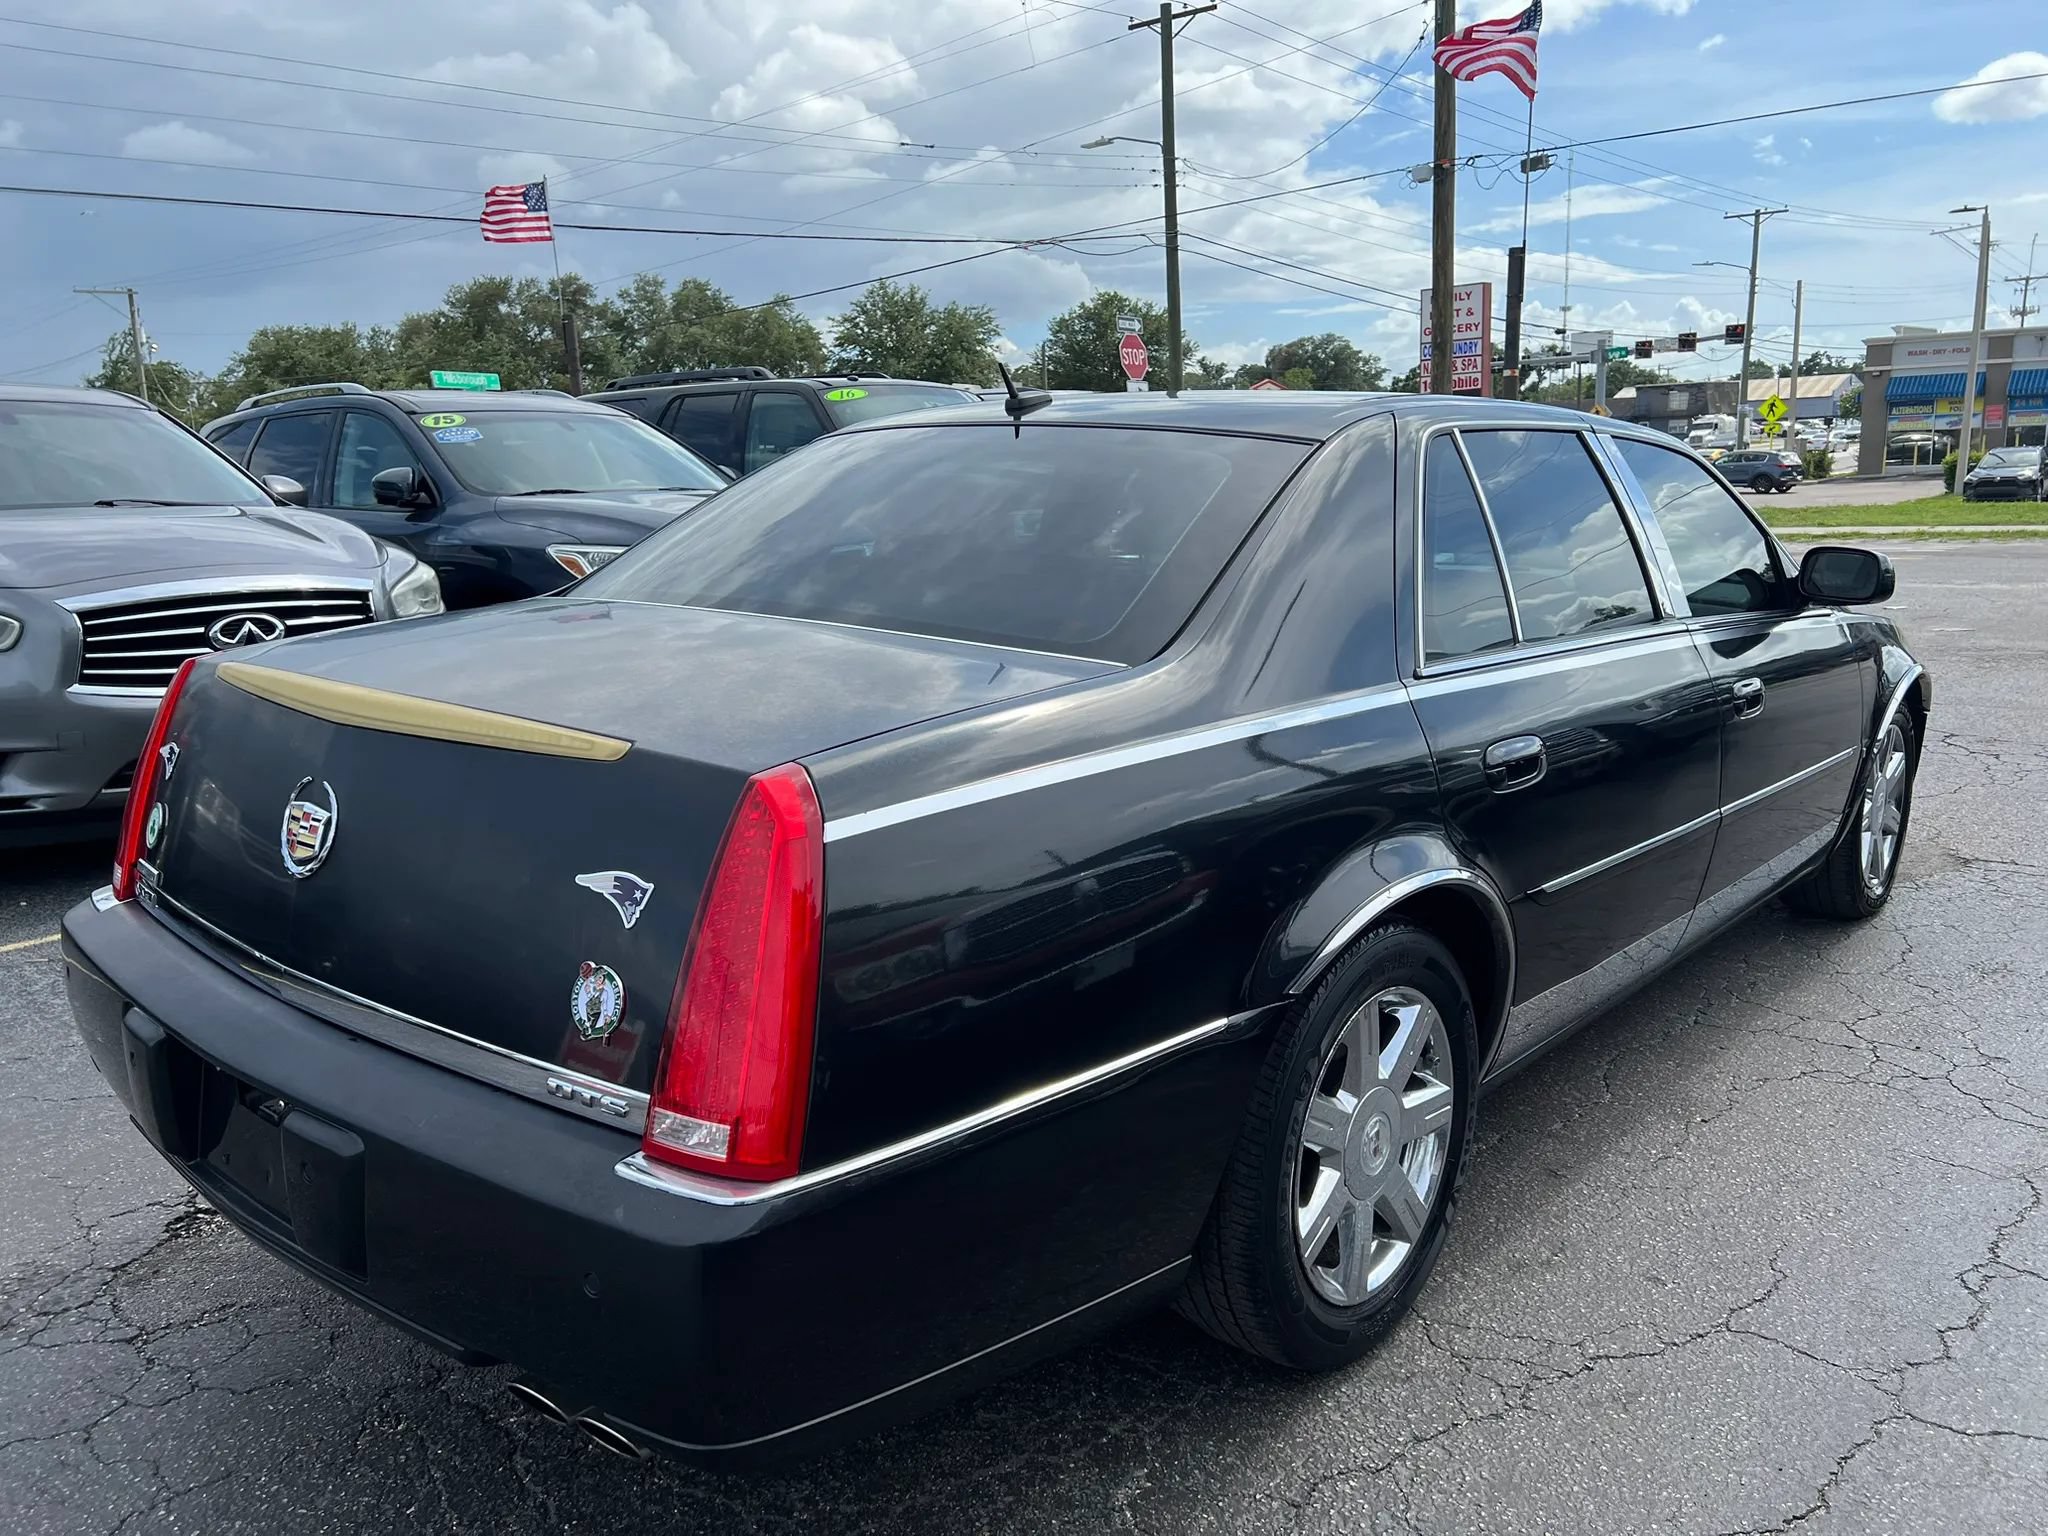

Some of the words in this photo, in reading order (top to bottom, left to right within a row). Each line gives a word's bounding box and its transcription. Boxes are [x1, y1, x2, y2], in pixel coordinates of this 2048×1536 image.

[1424, 322, 1480, 336] GERY
[1122, 348, 1145, 366] STOP
[1461, 358, 1478, 371] SPA
[840, 390, 855, 399] 16
[1891, 404, 1933, 415] ALTERATIONS
[432, 415, 456, 426] 15
[573, 978, 584, 1021] BOSTON
[611, 981, 621, 1022] CELTICS
[546, 1077, 630, 1118] DTS
